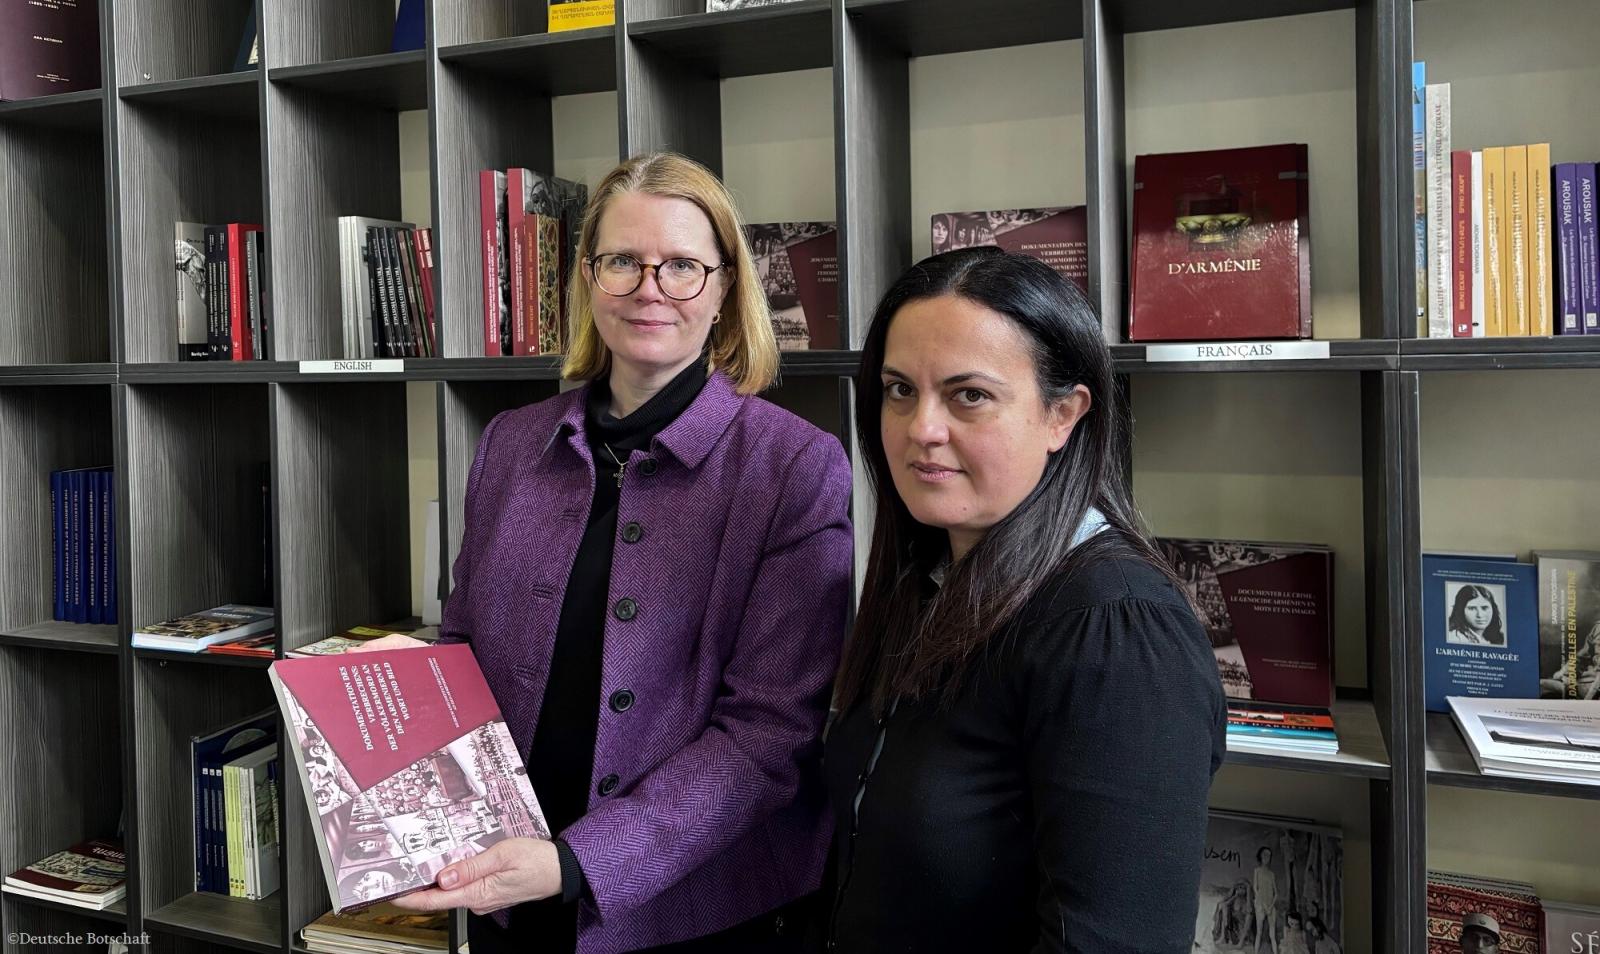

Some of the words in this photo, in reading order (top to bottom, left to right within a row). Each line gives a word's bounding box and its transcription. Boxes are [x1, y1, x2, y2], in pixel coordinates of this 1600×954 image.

[1562, 180, 1572, 225] AROUSIAK
[1582, 178, 1592, 223] AROUSIAK
[1168, 258, 1261, 275] D'ARMÉNIE
[384, 266, 392, 285] TRUTH
[1197, 345, 1273, 359] FRANÇAIS
[334, 362, 372, 370] ENGLISH
[1238, 588, 1281, 597] DOCUMENTER
[1568, 570, 1576, 617] PALESTINE
[1568, 620, 1576, 631] EN
[1435, 647, 1481, 658] L'ARMÉNIE
[1482, 652, 1520, 662] RAVAGÉE
[339, 666, 350, 681] DES
[361, 664, 371, 675] AN
[372, 663, 381, 672] IN
[383, 662, 395, 679] BILD
[376, 672, 400, 717] ARMENIERN
[390, 680, 401, 696] UND
[368, 676, 392, 732] VÖLKERMORD
[397, 697, 410, 720] WORT
[344, 682, 374, 751] DOKUMENTATION
[393, 718, 405, 734] DEN
[387, 734, 398, 751] DER
